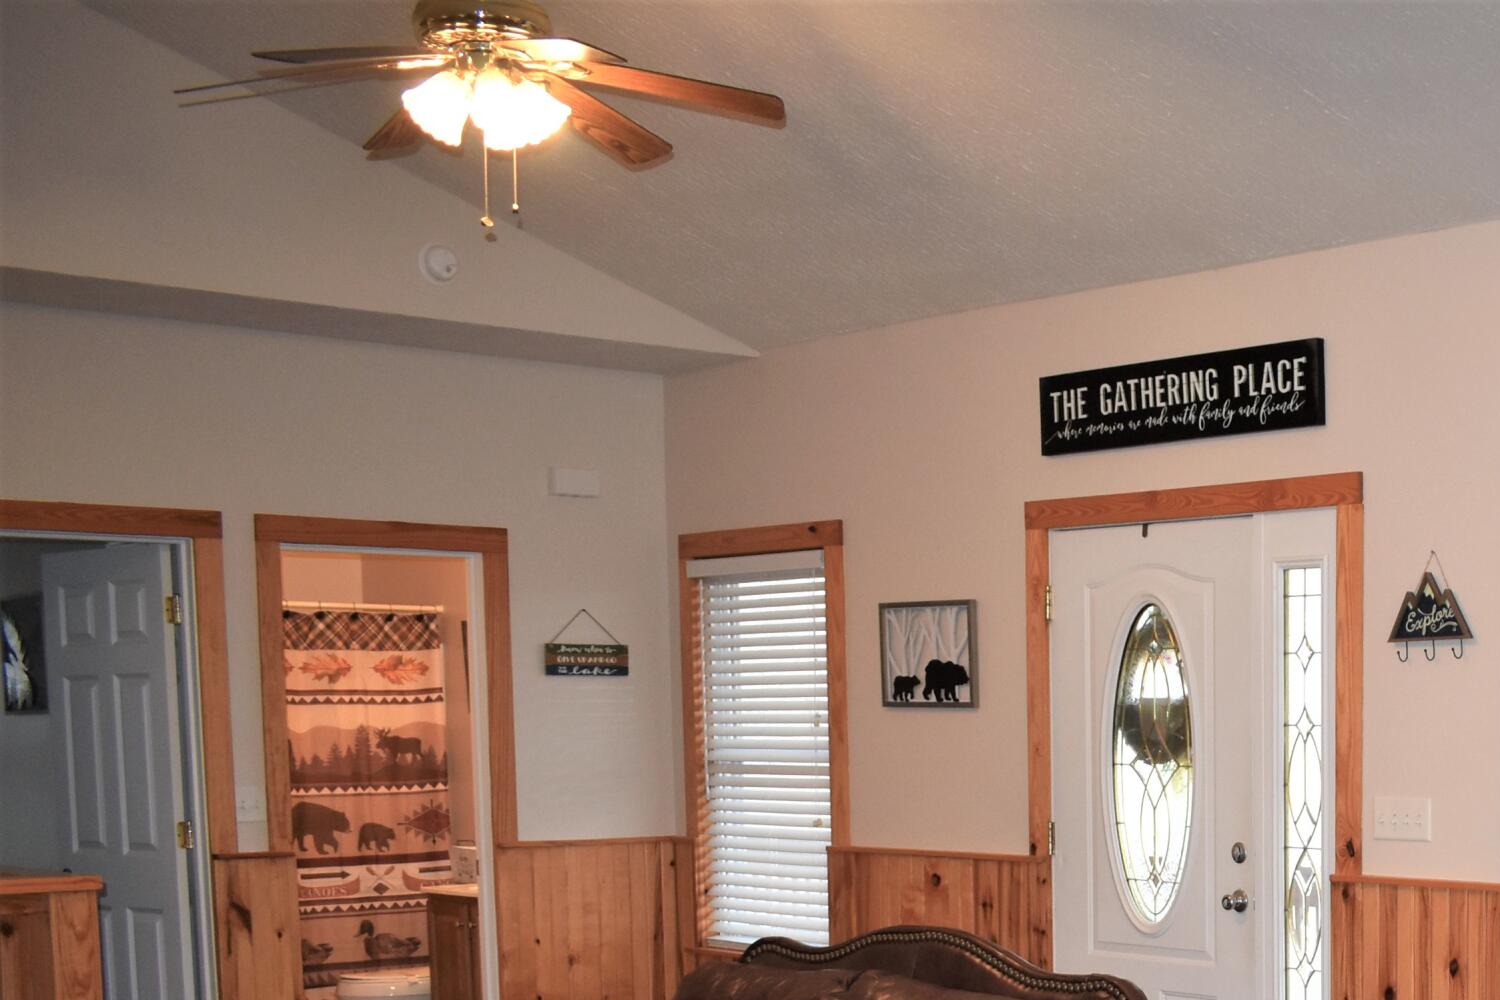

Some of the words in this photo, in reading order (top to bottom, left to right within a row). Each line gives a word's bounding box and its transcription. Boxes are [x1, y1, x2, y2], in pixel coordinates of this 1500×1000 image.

[1049, 386, 1088, 423] THE
[1099, 367, 1219, 416] GATHERING
[1232, 356, 1307, 398] PLACE
[1053, 420, 1083, 441] where
[1085, 422, 1125, 437] memories
[1128, 419, 1141, 430] are
[1144, 406, 1169, 429] made
[1172, 403, 1198, 425] with
[1198, 398, 1236, 431] family
[1238, 395, 1261, 418] and
[1259, 391, 1306, 425] friends
[1405, 603, 1456, 637] Explore
